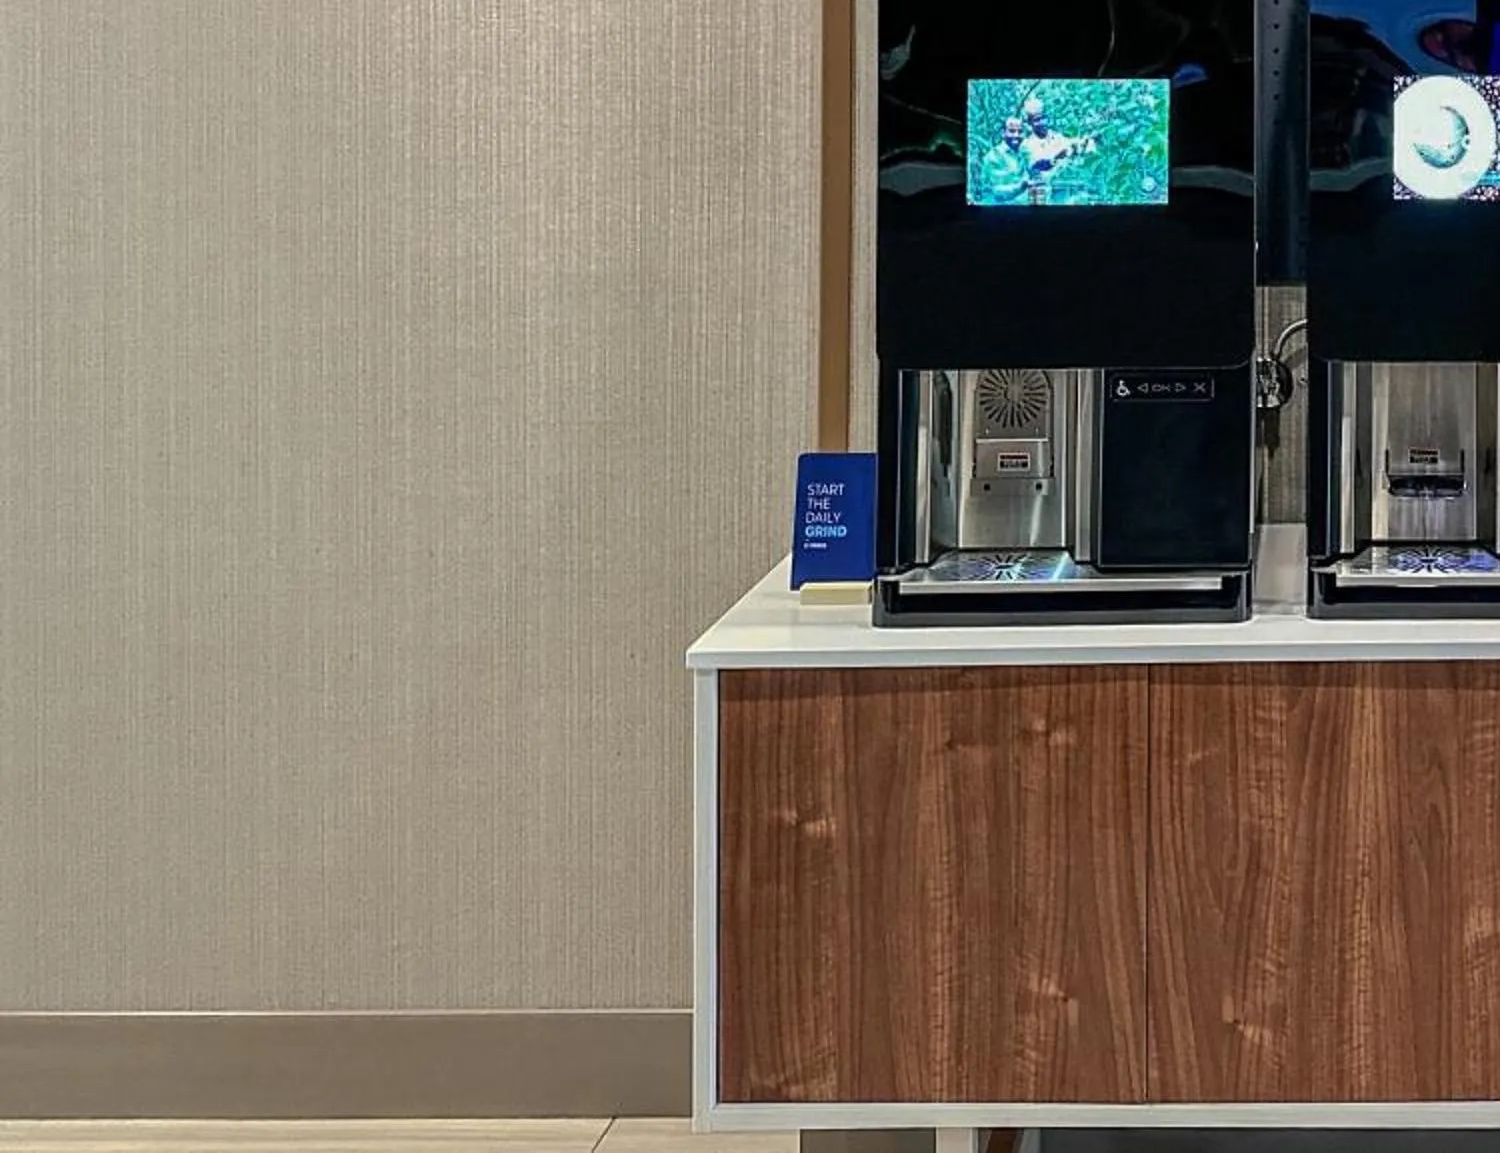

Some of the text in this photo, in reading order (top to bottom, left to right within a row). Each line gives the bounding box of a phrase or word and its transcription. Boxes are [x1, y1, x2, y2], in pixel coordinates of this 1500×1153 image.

[807, 483, 845, 496] START
[808, 497, 831, 510] THE
[805, 511, 842, 524] DAILY
[805, 526, 848, 538] GRIND
